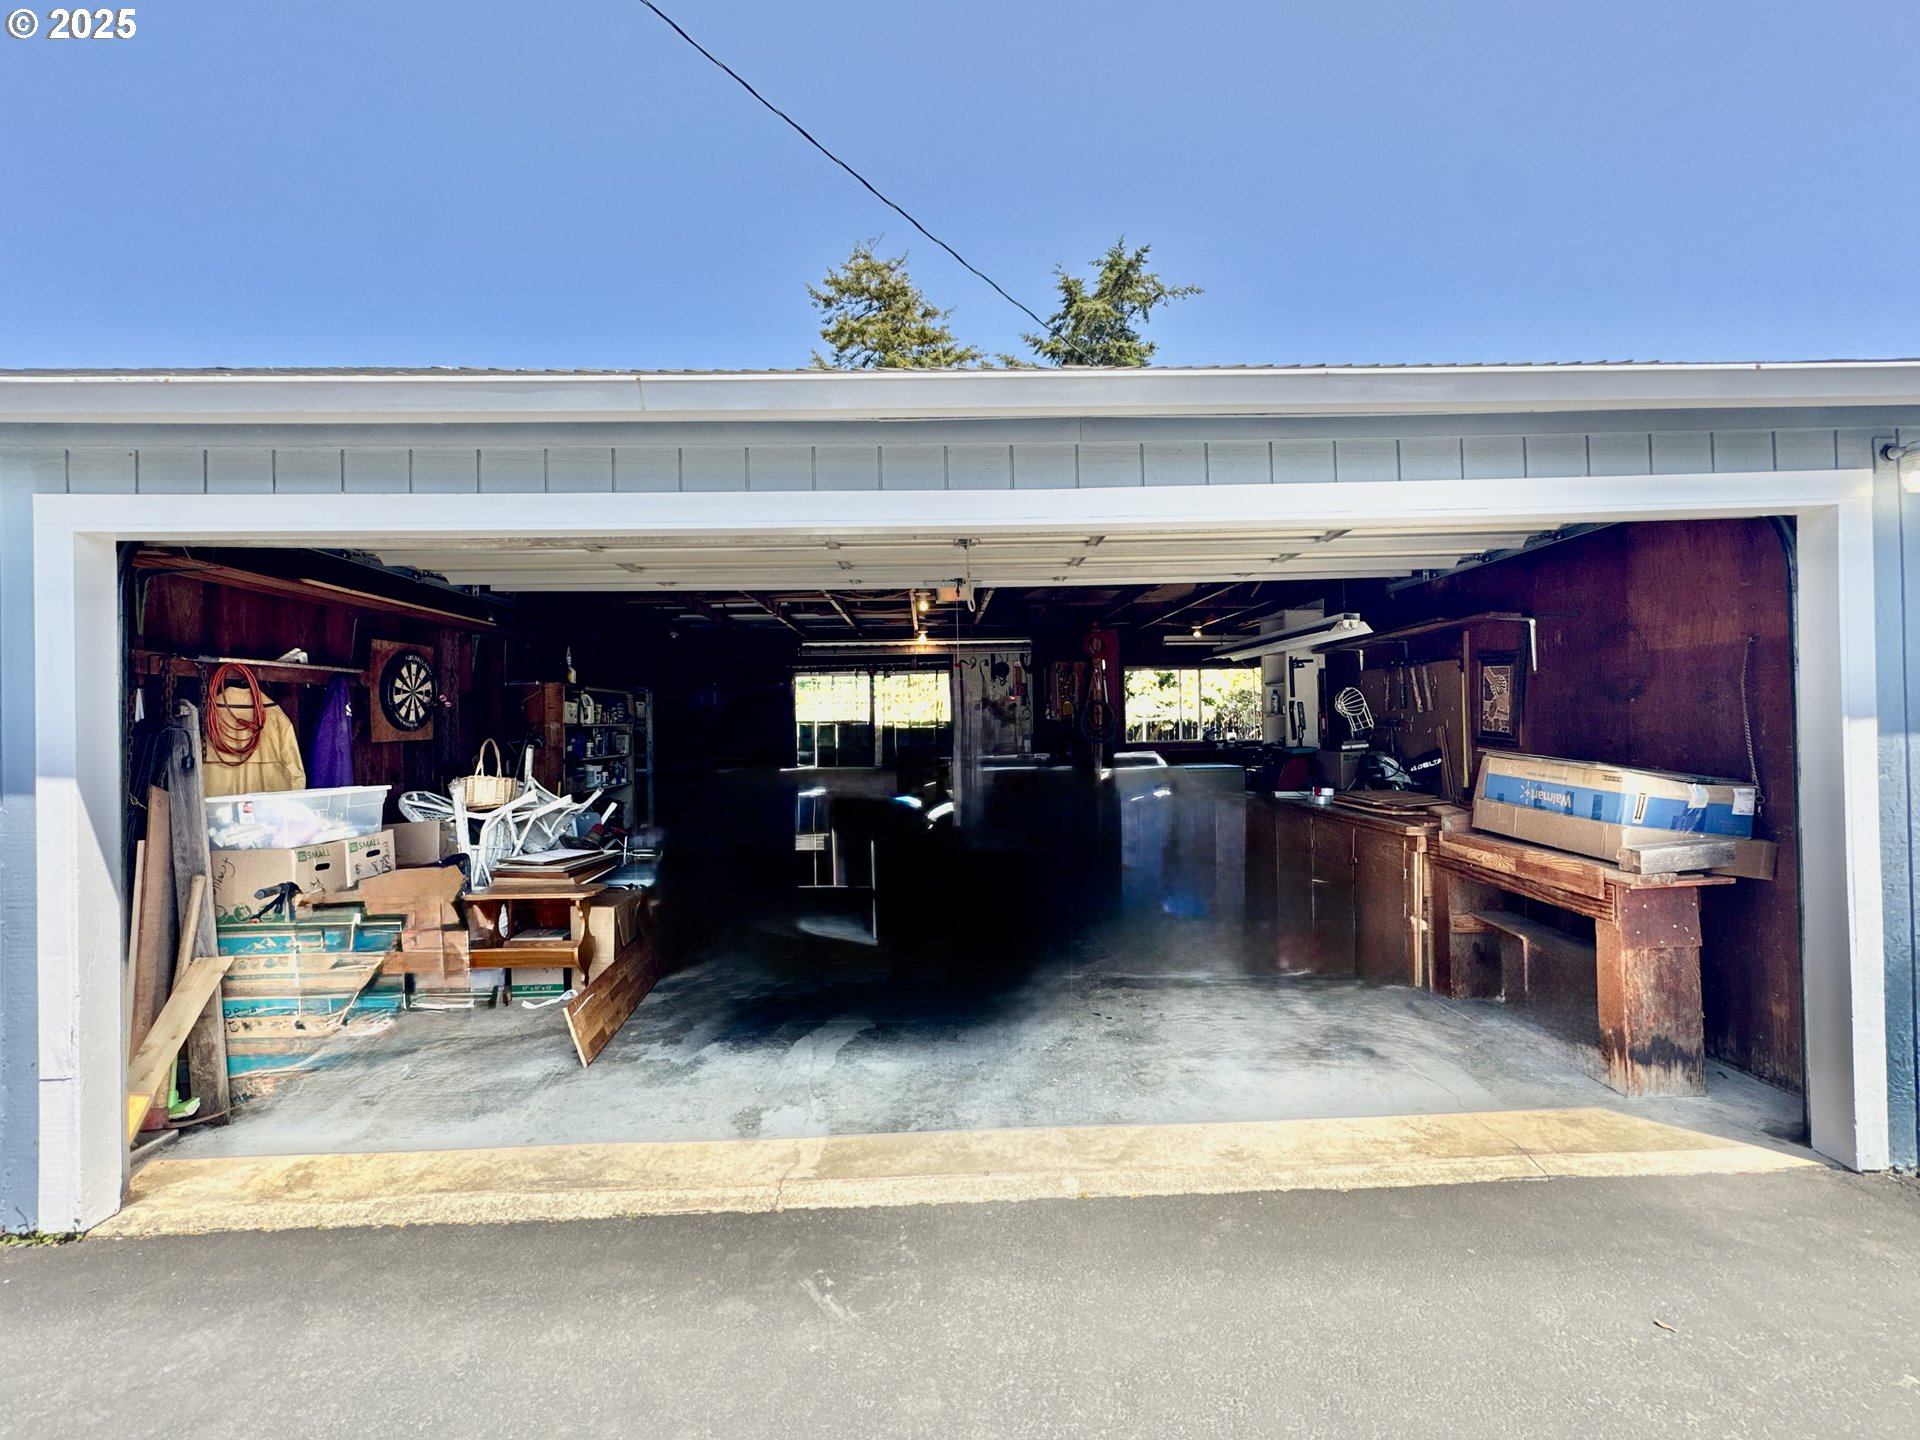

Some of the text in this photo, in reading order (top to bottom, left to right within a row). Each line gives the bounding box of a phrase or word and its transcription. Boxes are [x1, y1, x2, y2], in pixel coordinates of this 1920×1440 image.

[1417, 758, 1442, 770] DELTA
[1530, 788, 1571, 808] Walmart
[358, 839, 380, 849] SMALL
[306, 849, 330, 859] SMALL
